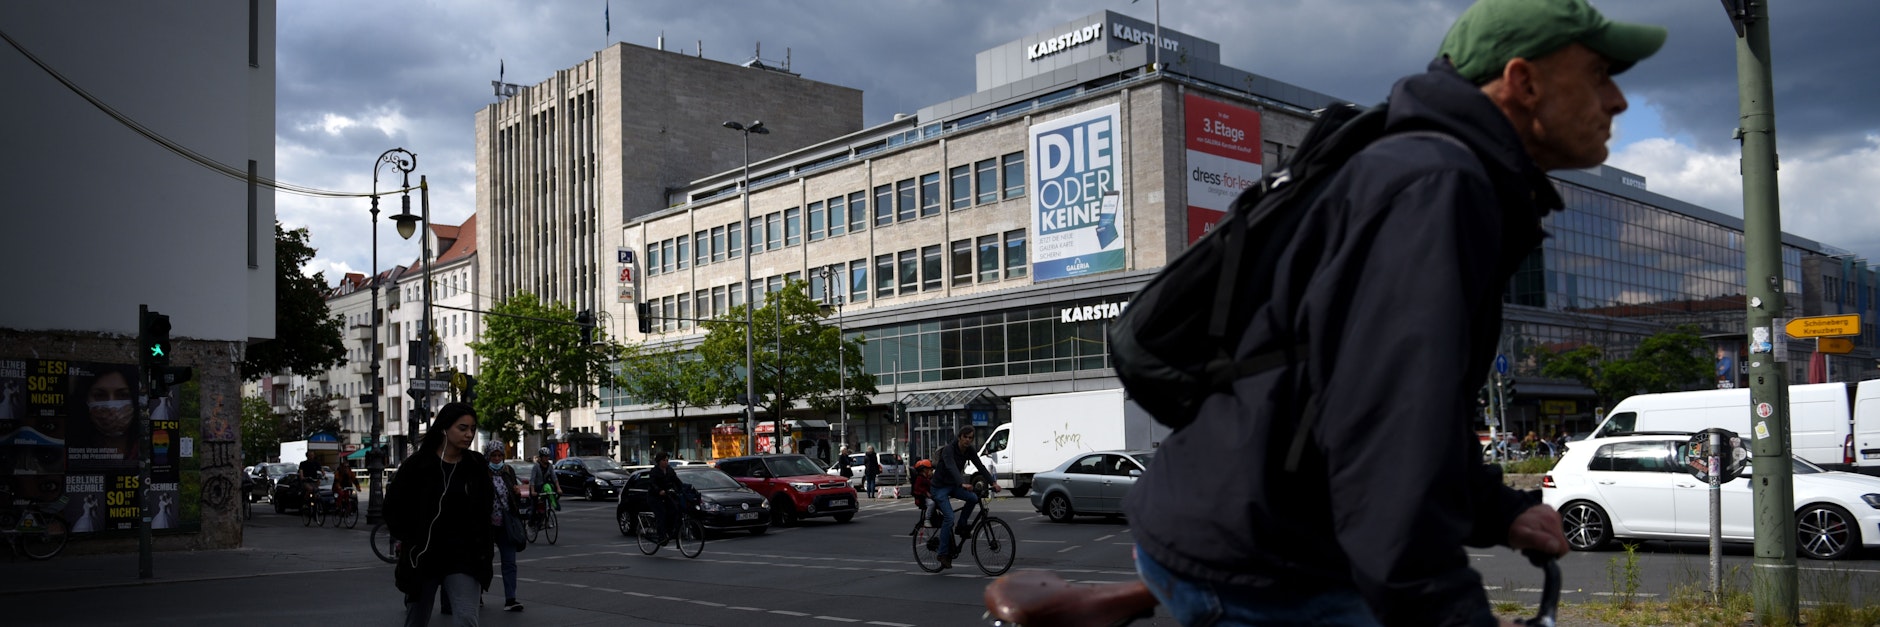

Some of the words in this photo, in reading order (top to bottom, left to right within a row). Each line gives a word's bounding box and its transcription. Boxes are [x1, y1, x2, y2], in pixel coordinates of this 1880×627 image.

[1027, 22, 1102, 60] KARSTADT
[1113, 22, 1179, 51] KARSTADT
[1203, 118, 1213, 134] 3.
[1214, 120, 1245, 142] Etage
[1039, 120, 1111, 181] DIE
[1040, 169, 1110, 210] ODER
[1041, 201, 1100, 232] KEINE
[1039, 235, 1051, 244] JETZT
[1052, 234, 1060, 242] DIE
[1060, 232, 1073, 241] NEUE
[1039, 243, 1059, 252] GALERIA
[1059, 240, 1074, 249] KARTE
[1066, 262, 1090, 272] GALERIA
[1803, 319, 1849, 327] Schöneberg
[1803, 327, 1843, 335] Kreuzberg
[47, 360, 67, 375] ES!
[28, 376, 46, 392] SO
[31, 393, 64, 405] NICHT!
[66, 475, 104, 485] BERLINER
[66, 484, 104, 493] ENSEMBLE
[106, 490, 125, 506] SO
[125, 490, 135, 499] IST
[109, 507, 141, 519] NICHT!
